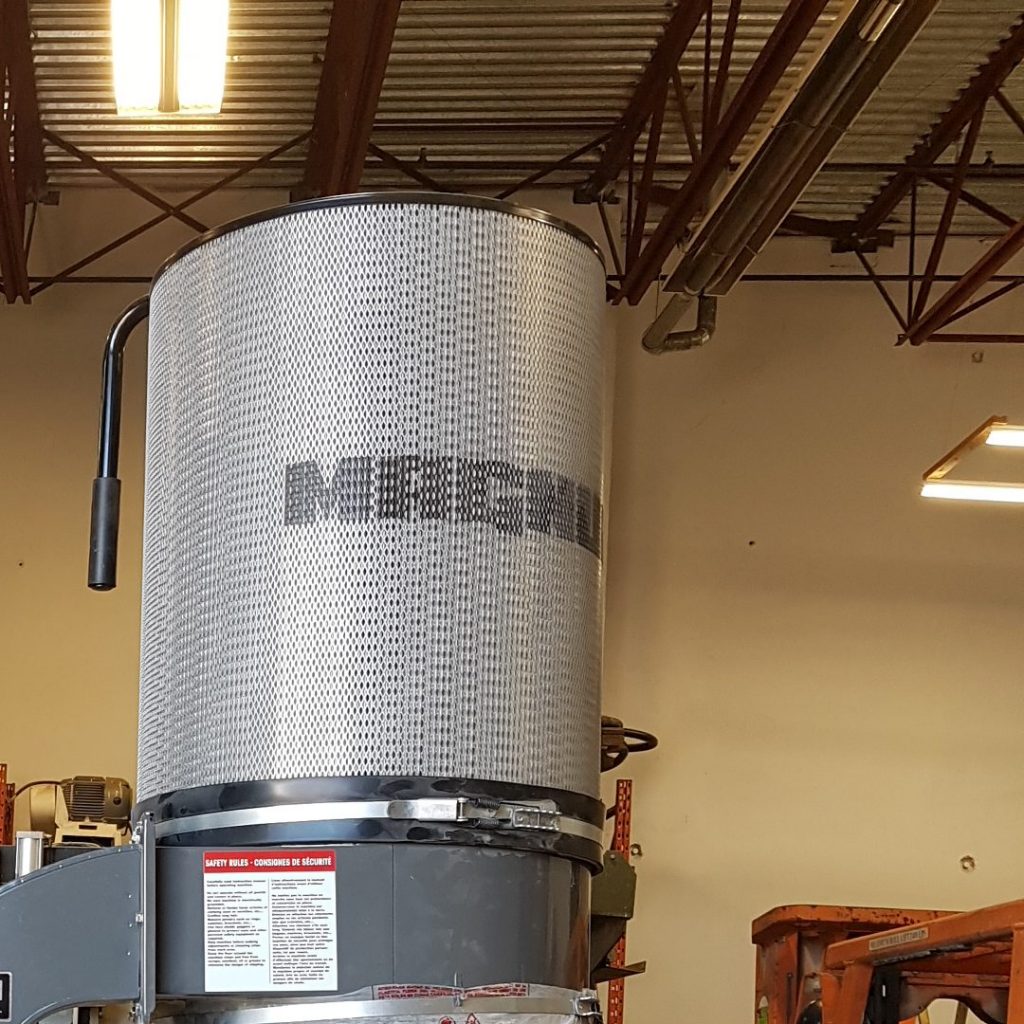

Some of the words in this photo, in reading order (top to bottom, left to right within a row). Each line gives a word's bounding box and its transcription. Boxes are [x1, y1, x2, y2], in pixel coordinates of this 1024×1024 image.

[205, 858, 227, 868] SAFETY
[229, 858, 249, 867] RULES
[254, 857, 290, 867] CONSIGNES
[291, 857, 301, 866] DE
[302, 855, 332, 866] SÉCURITÉ
